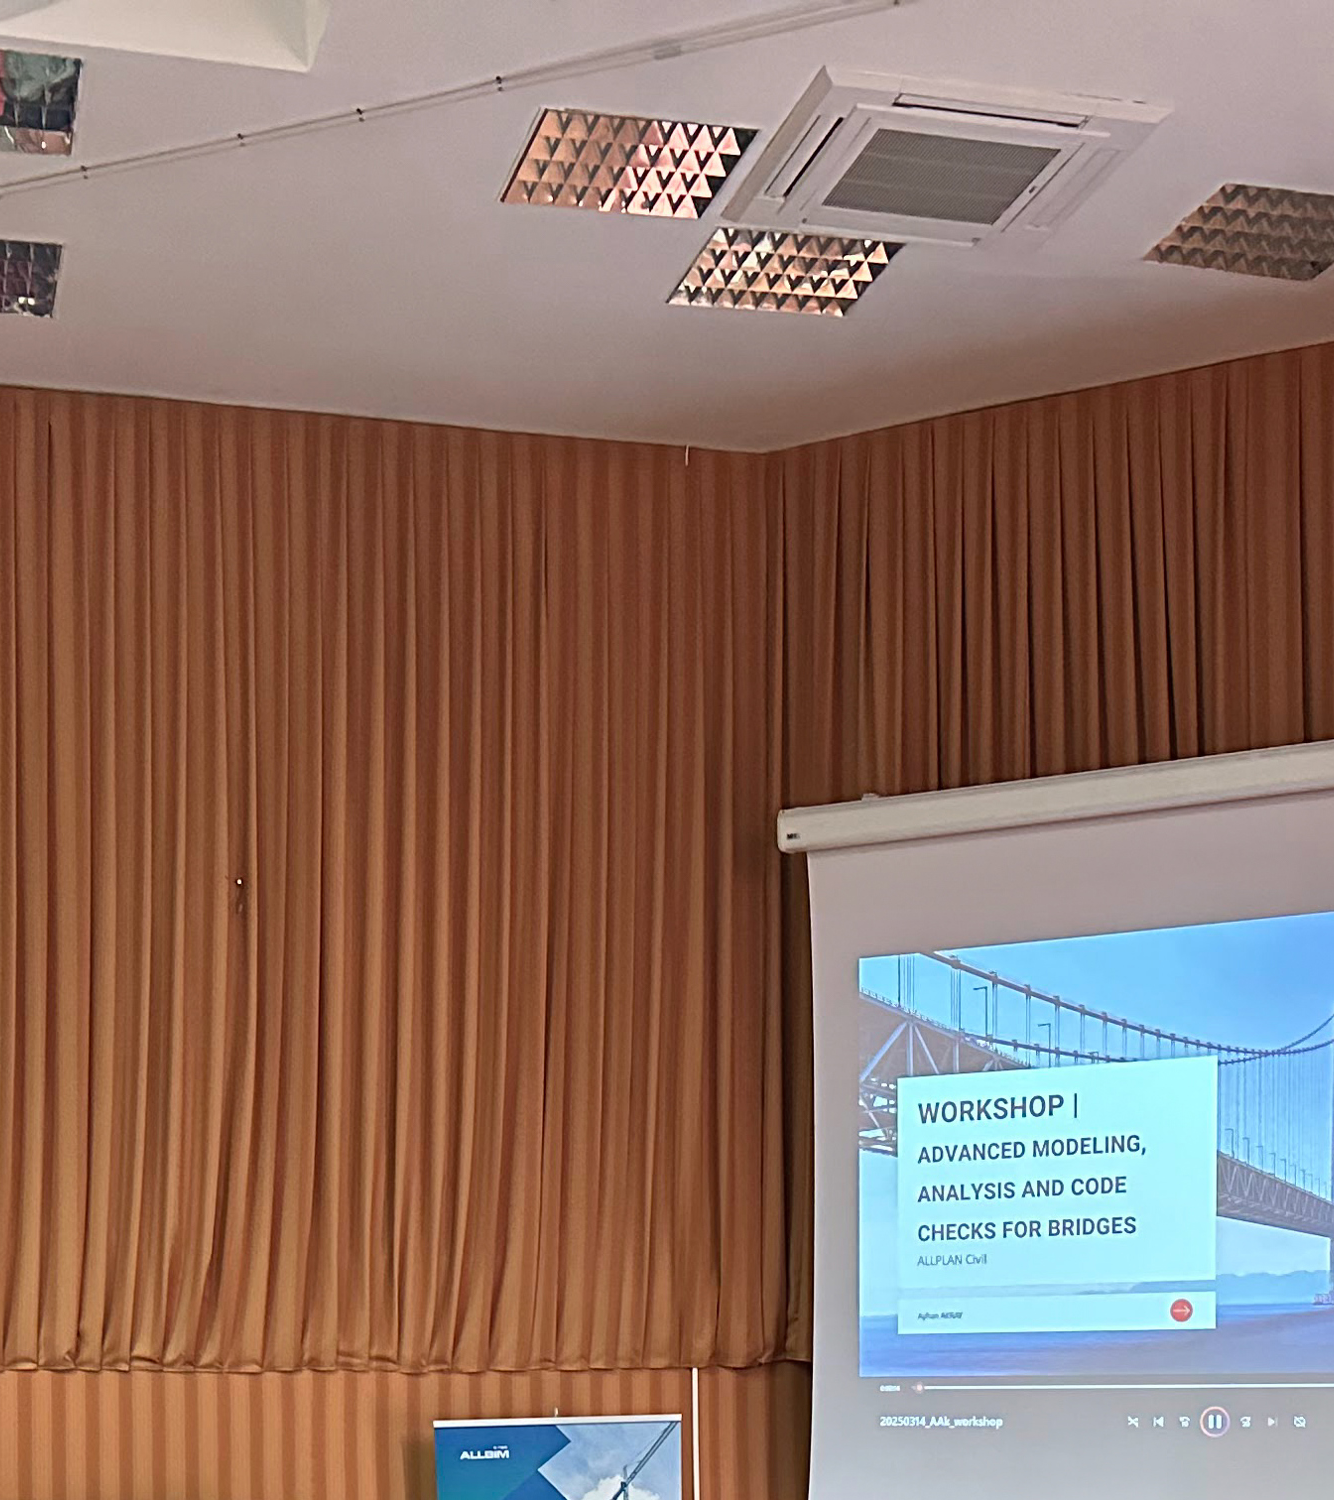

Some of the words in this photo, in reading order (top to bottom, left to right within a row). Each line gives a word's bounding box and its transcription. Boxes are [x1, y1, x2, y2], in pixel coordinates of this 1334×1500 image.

[918, 1094, 1064, 1125] WORKSHOP
[917, 1141, 1025, 1164] ADVANCED
[1033, 1135, 1146, 1157] MODELING,
[917, 1182, 1015, 1202] ANALYSIS
[1022, 1179, 1064, 1198] AND
[1071, 1176, 1127, 1195] CODE
[918, 1222, 996, 1242] CHECKS
[1003, 1220, 1041, 1238] FOR
[1049, 1217, 1137, 1237] BRIDGES
[917, 1255, 963, 1266] ALLPLAN
[965, 1254, 987, 1265] Civil
[460, 1450, 509, 1460] ALLBIM
